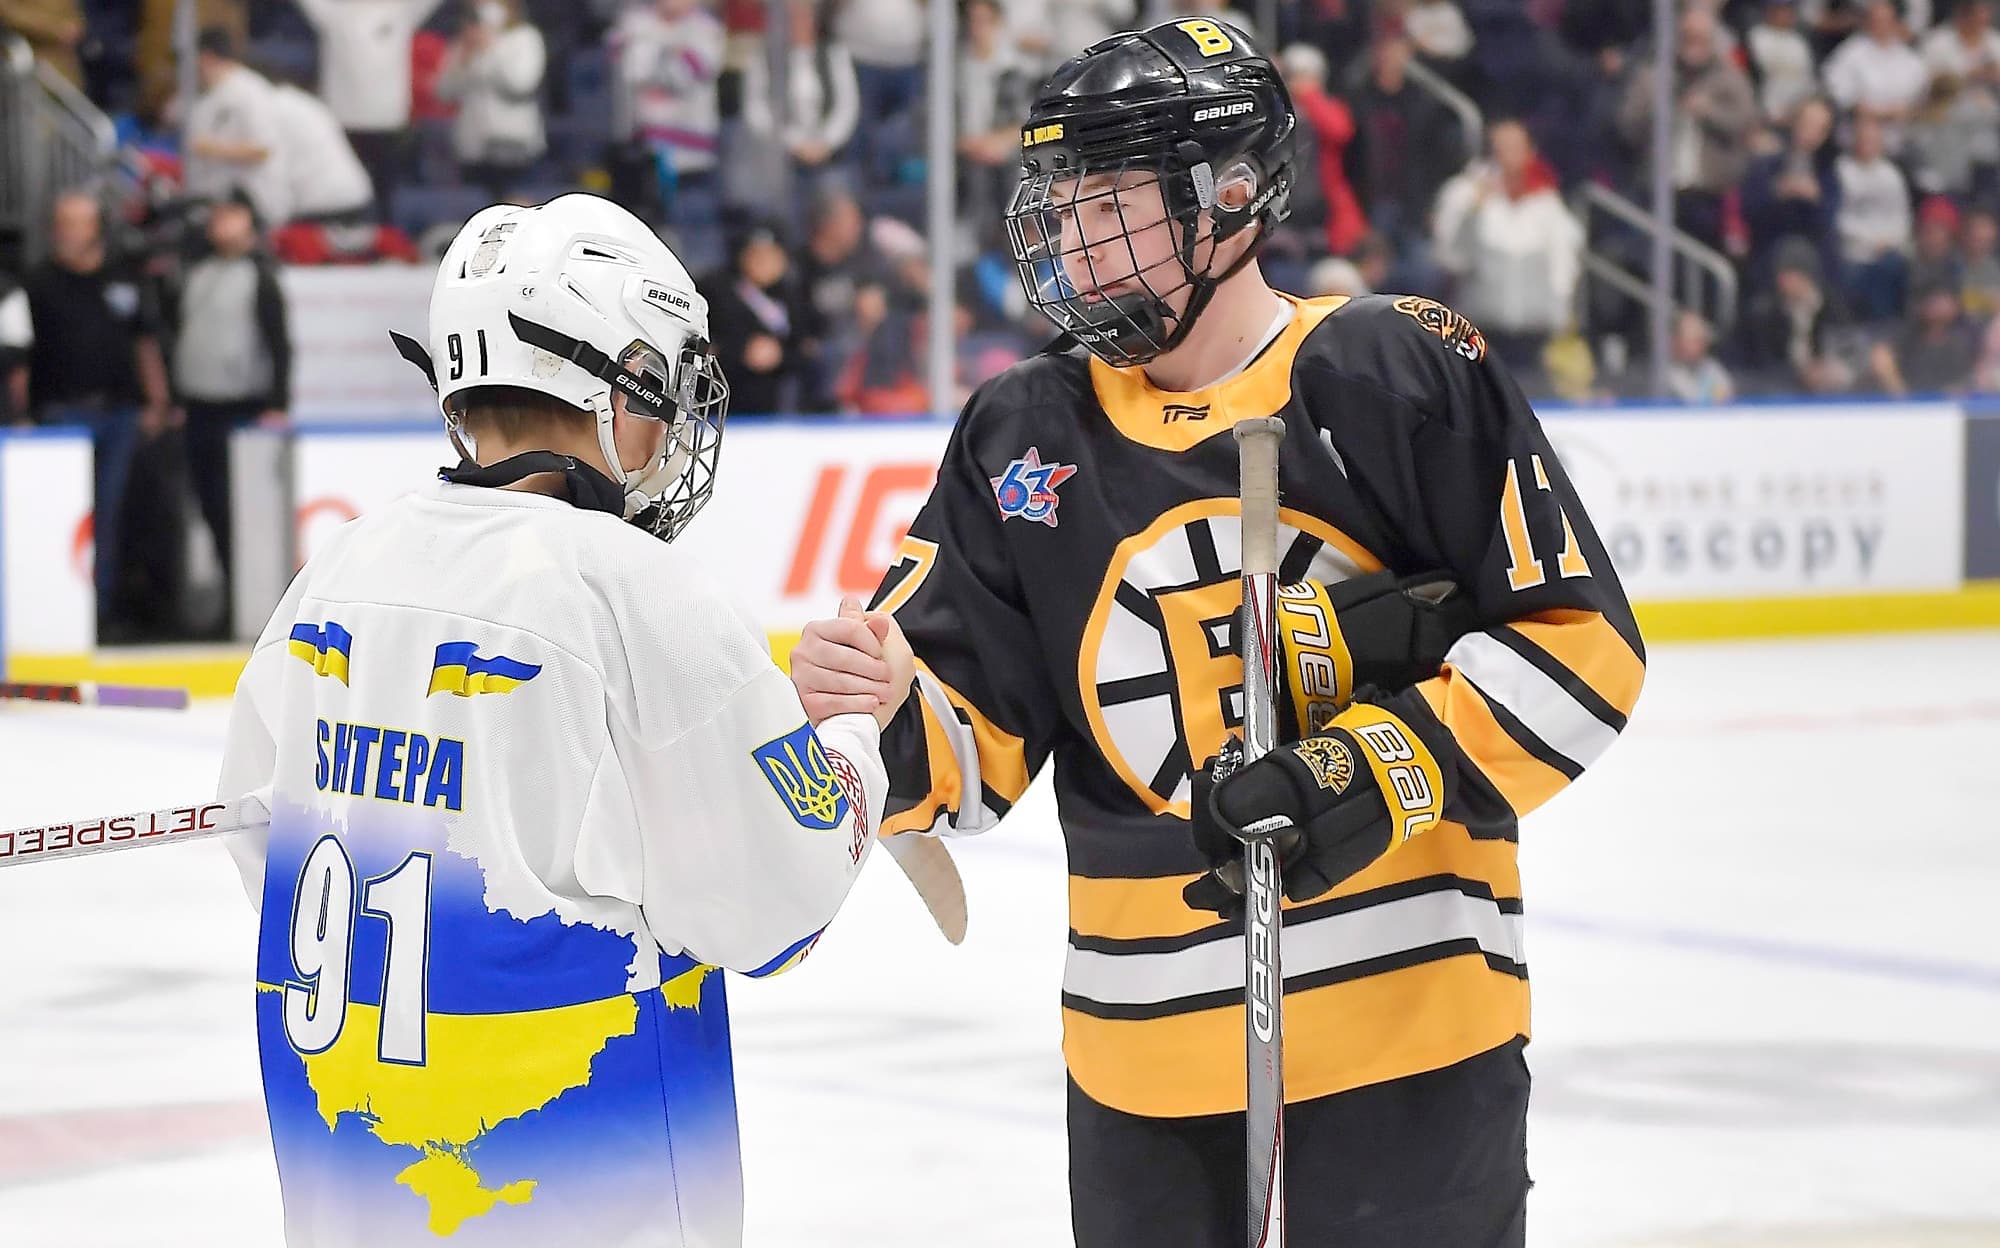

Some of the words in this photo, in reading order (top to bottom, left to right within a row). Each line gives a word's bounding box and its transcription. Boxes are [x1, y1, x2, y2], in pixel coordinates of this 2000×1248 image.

[1177, 19, 1235, 58] B
[1193, 101, 1254, 123] BAUER
[647, 288, 692, 312] BAUER
[448, 329, 489, 380] 91
[615, 373, 664, 409] BAUER
[315, 718, 465, 812] SHTEPA
[283, 833, 434, 1068] 91
[1250, 838, 1275, 1043] SPEED
